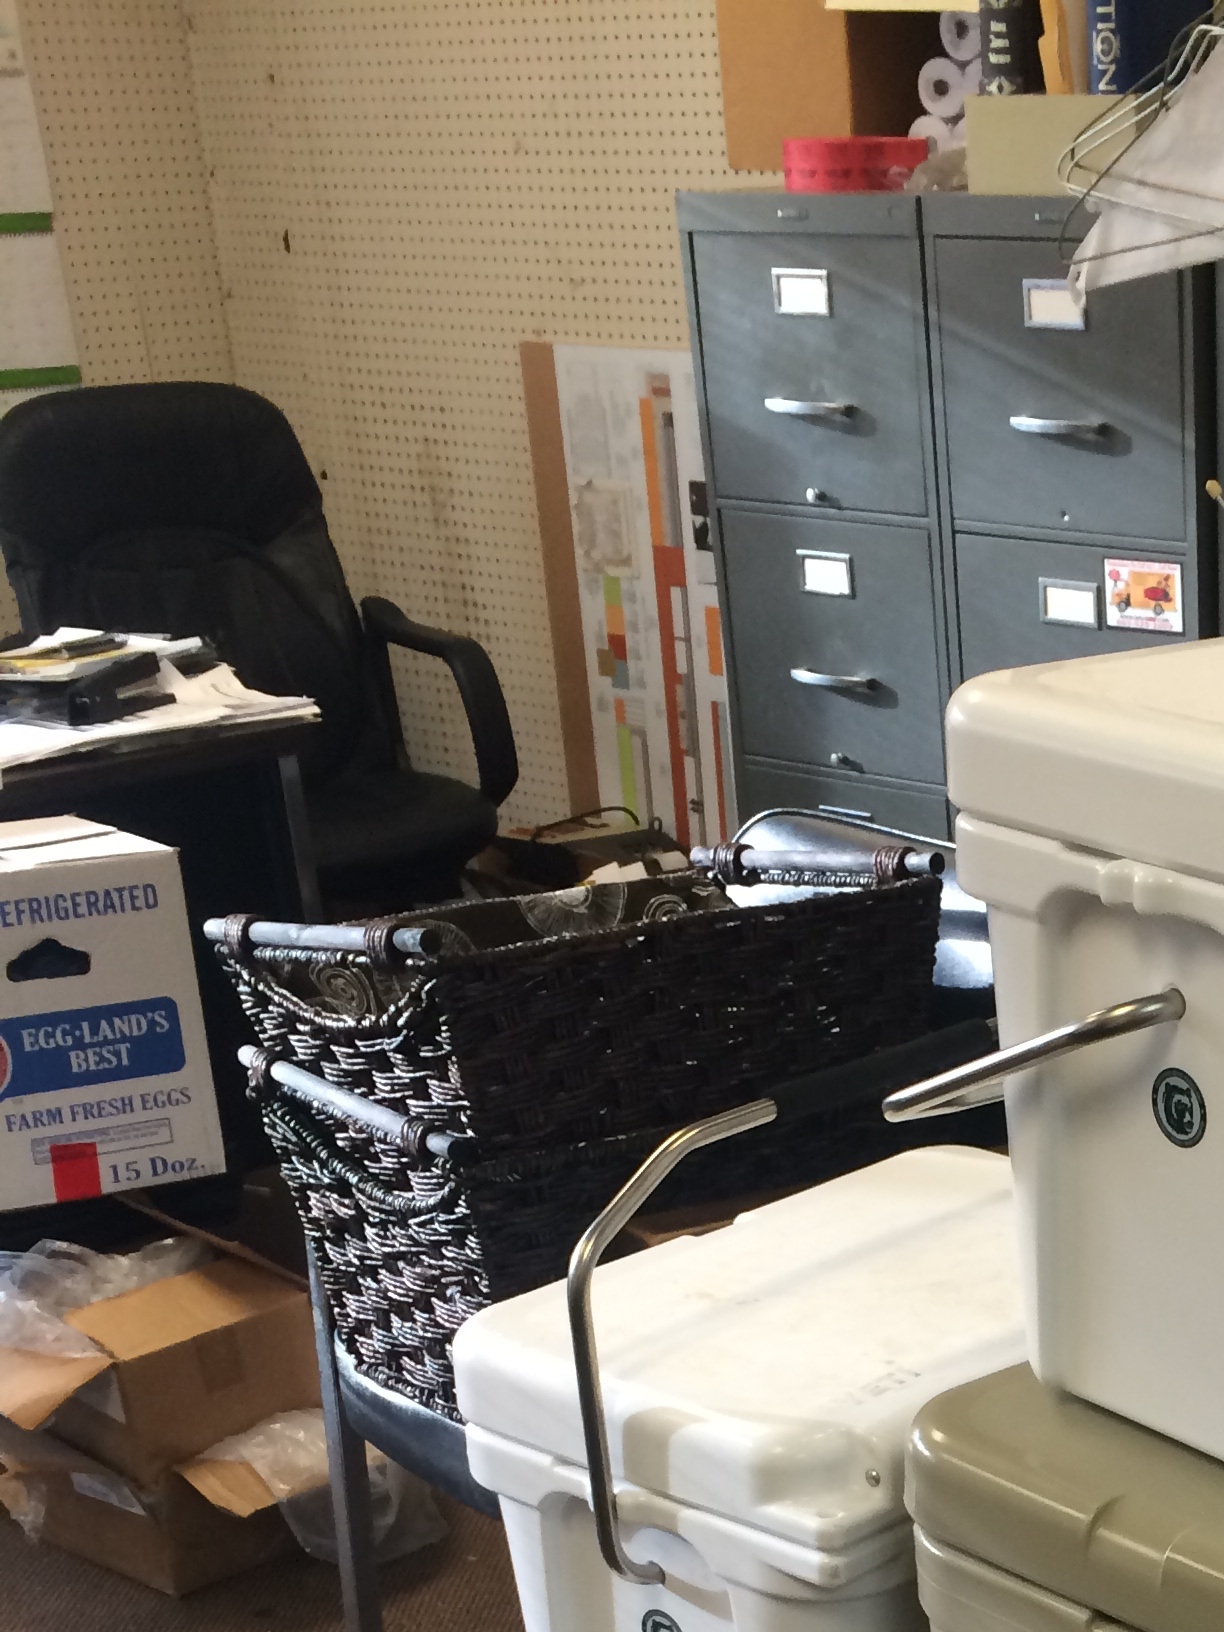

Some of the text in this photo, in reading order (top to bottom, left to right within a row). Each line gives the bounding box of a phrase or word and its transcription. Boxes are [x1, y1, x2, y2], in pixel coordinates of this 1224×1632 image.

[1096, 0, 1117, 91] TION
[0, 883, 159, 928] EFRIGERATED
[69, 1043, 131, 1073] BEST
[5, 1087, 192, 1132] FARM FRESH EGGS
[109, 1161, 141, 1184] 15
